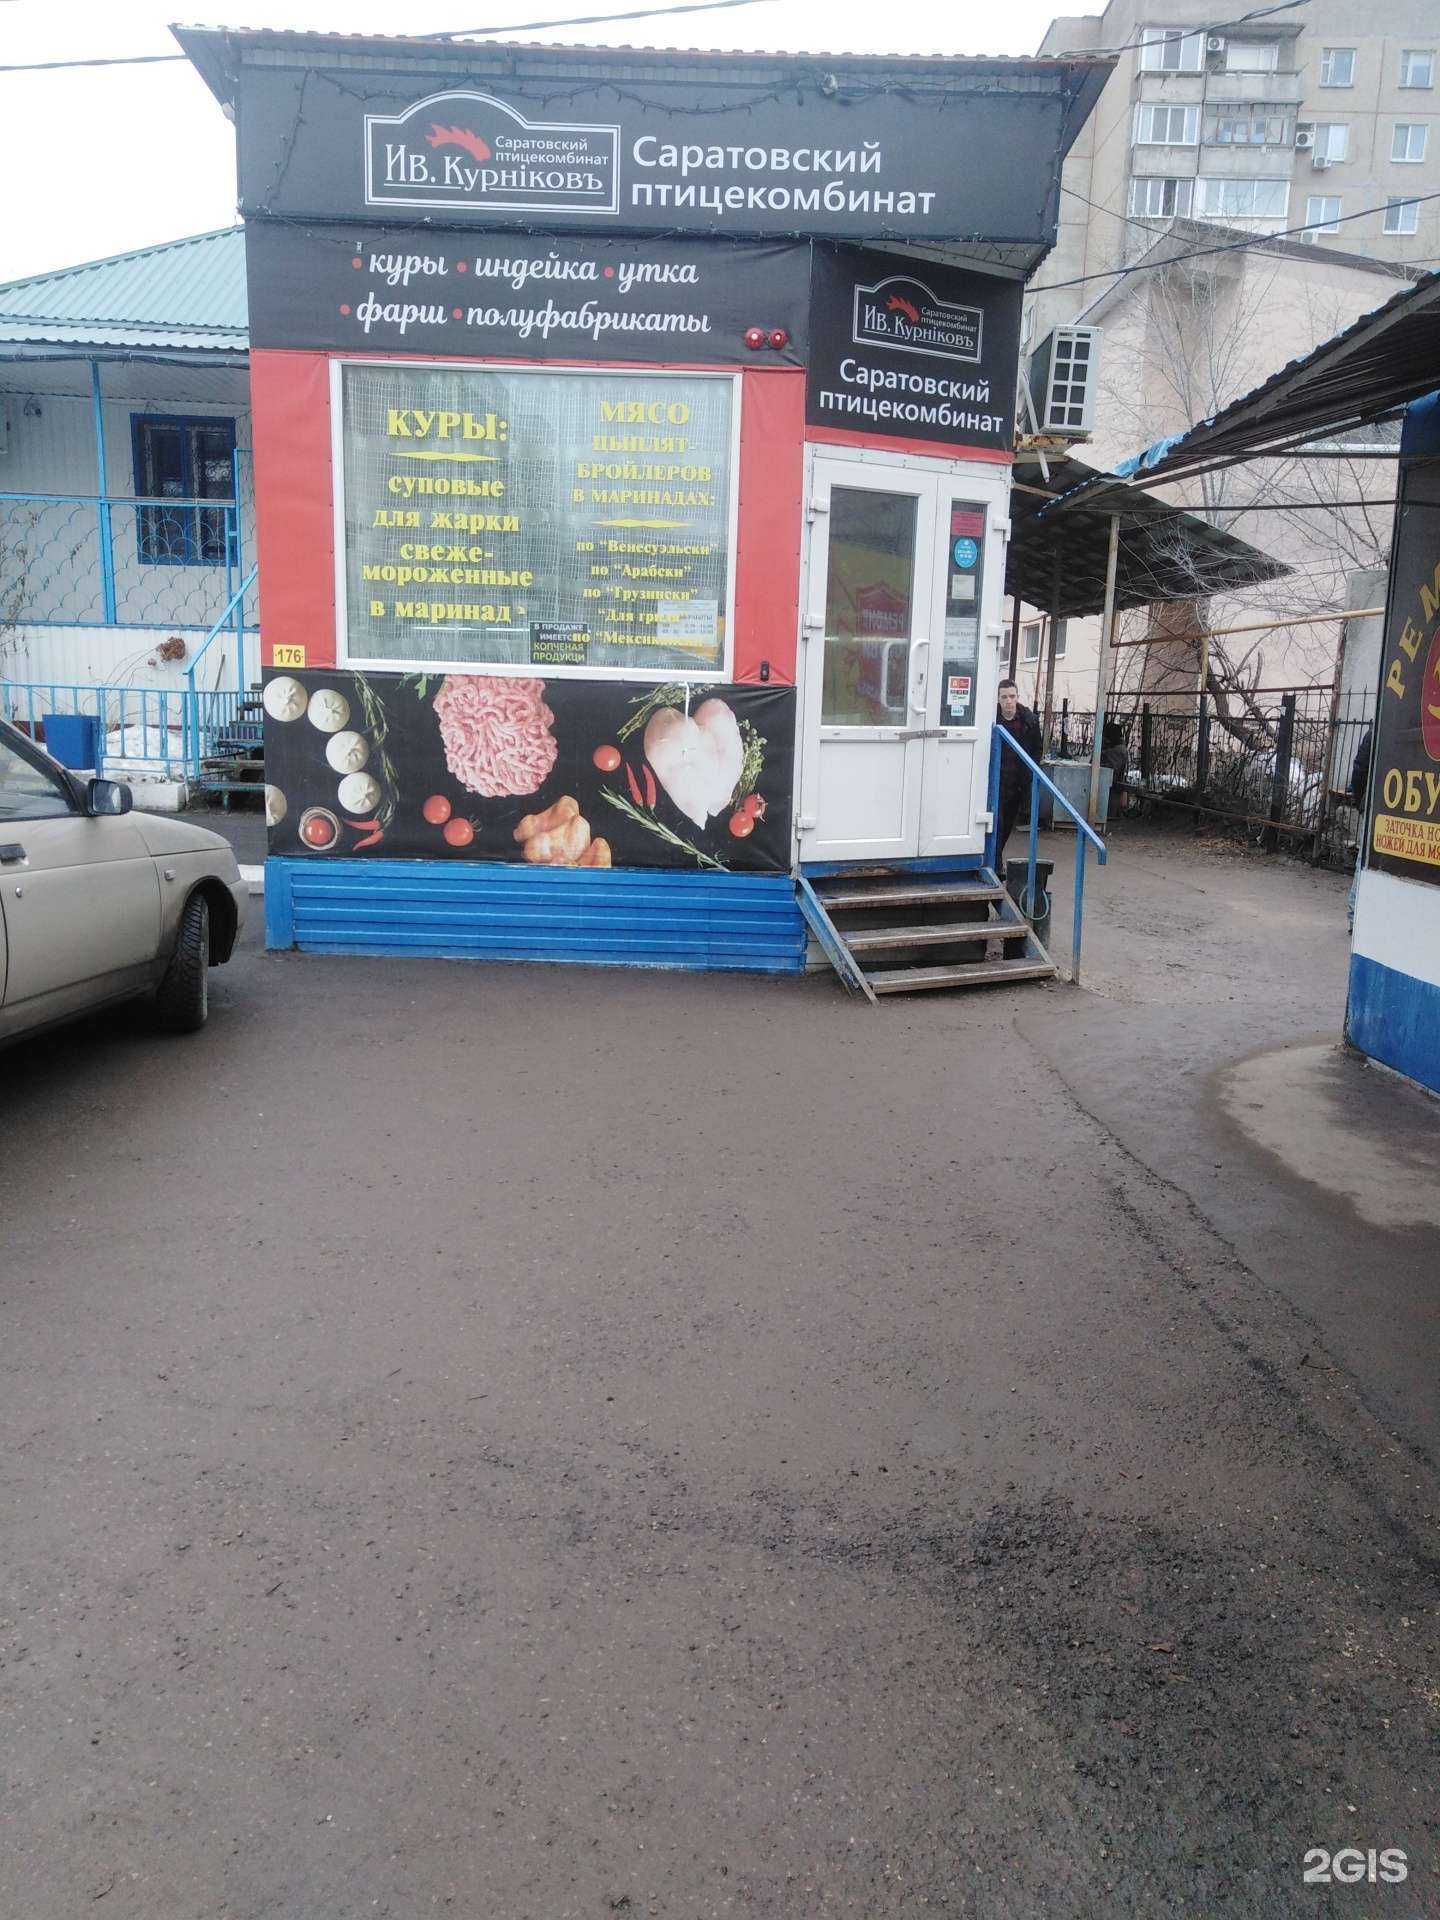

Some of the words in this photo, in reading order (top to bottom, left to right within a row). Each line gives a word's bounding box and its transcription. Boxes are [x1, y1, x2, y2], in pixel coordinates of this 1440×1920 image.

[495, 135, 588, 151] Саратовский
[495, 151, 609, 167] птицекомбинат
[632, 135, 882, 175] Саратовский
[631, 180, 936, 215] птицекомбинат
[369, 254, 448, 286] куры
[475, 252, 598, 290] индейка
[618, 262, 699, 293] утка
[356, 292, 448, 335] фарш
[466, 300, 712, 341] полуфабрикаты
[921, 306, 968, 322] Саратовский
[920, 316, 977, 333] птицекомбинат
[839, 358, 990, 403] Саратовский
[600, 400, 690, 425] МЯСО
[819, 391, 1003, 433] птицекомбинат
[387, 409, 507, 441] КУРЫ:
[576, 459, 712, 482] БРОЙЛЕРОВ
[388, 475, 505, 498] суповые
[573, 488, 584, 503] В
[591, 489, 716, 507] МАРИНАДАХ:
[372, 509, 421, 529] для
[430, 511, 521, 535] жарки
[400, 543, 494, 563] свеже-
[576, 540, 594, 551] по
[362, 564, 534, 587] мороженные
[591, 565, 609, 576] по
[583, 588, 601, 599] по
[369, 600, 386, 617] в
[539, 633, 573, 641] ИМЕЕТС
[542, 623, 584, 632] ПРОДАЖЕ
[277, 649, 302, 664] 176
[533, 642, 584, 651] КОПЧЕНАЯ
[1384, 819, 1424, 839] ЗАТОЧКА
[1375, 833, 1405, 853] НОЖЕЙ
[1406, 839, 1425, 857] ДЛЯ
